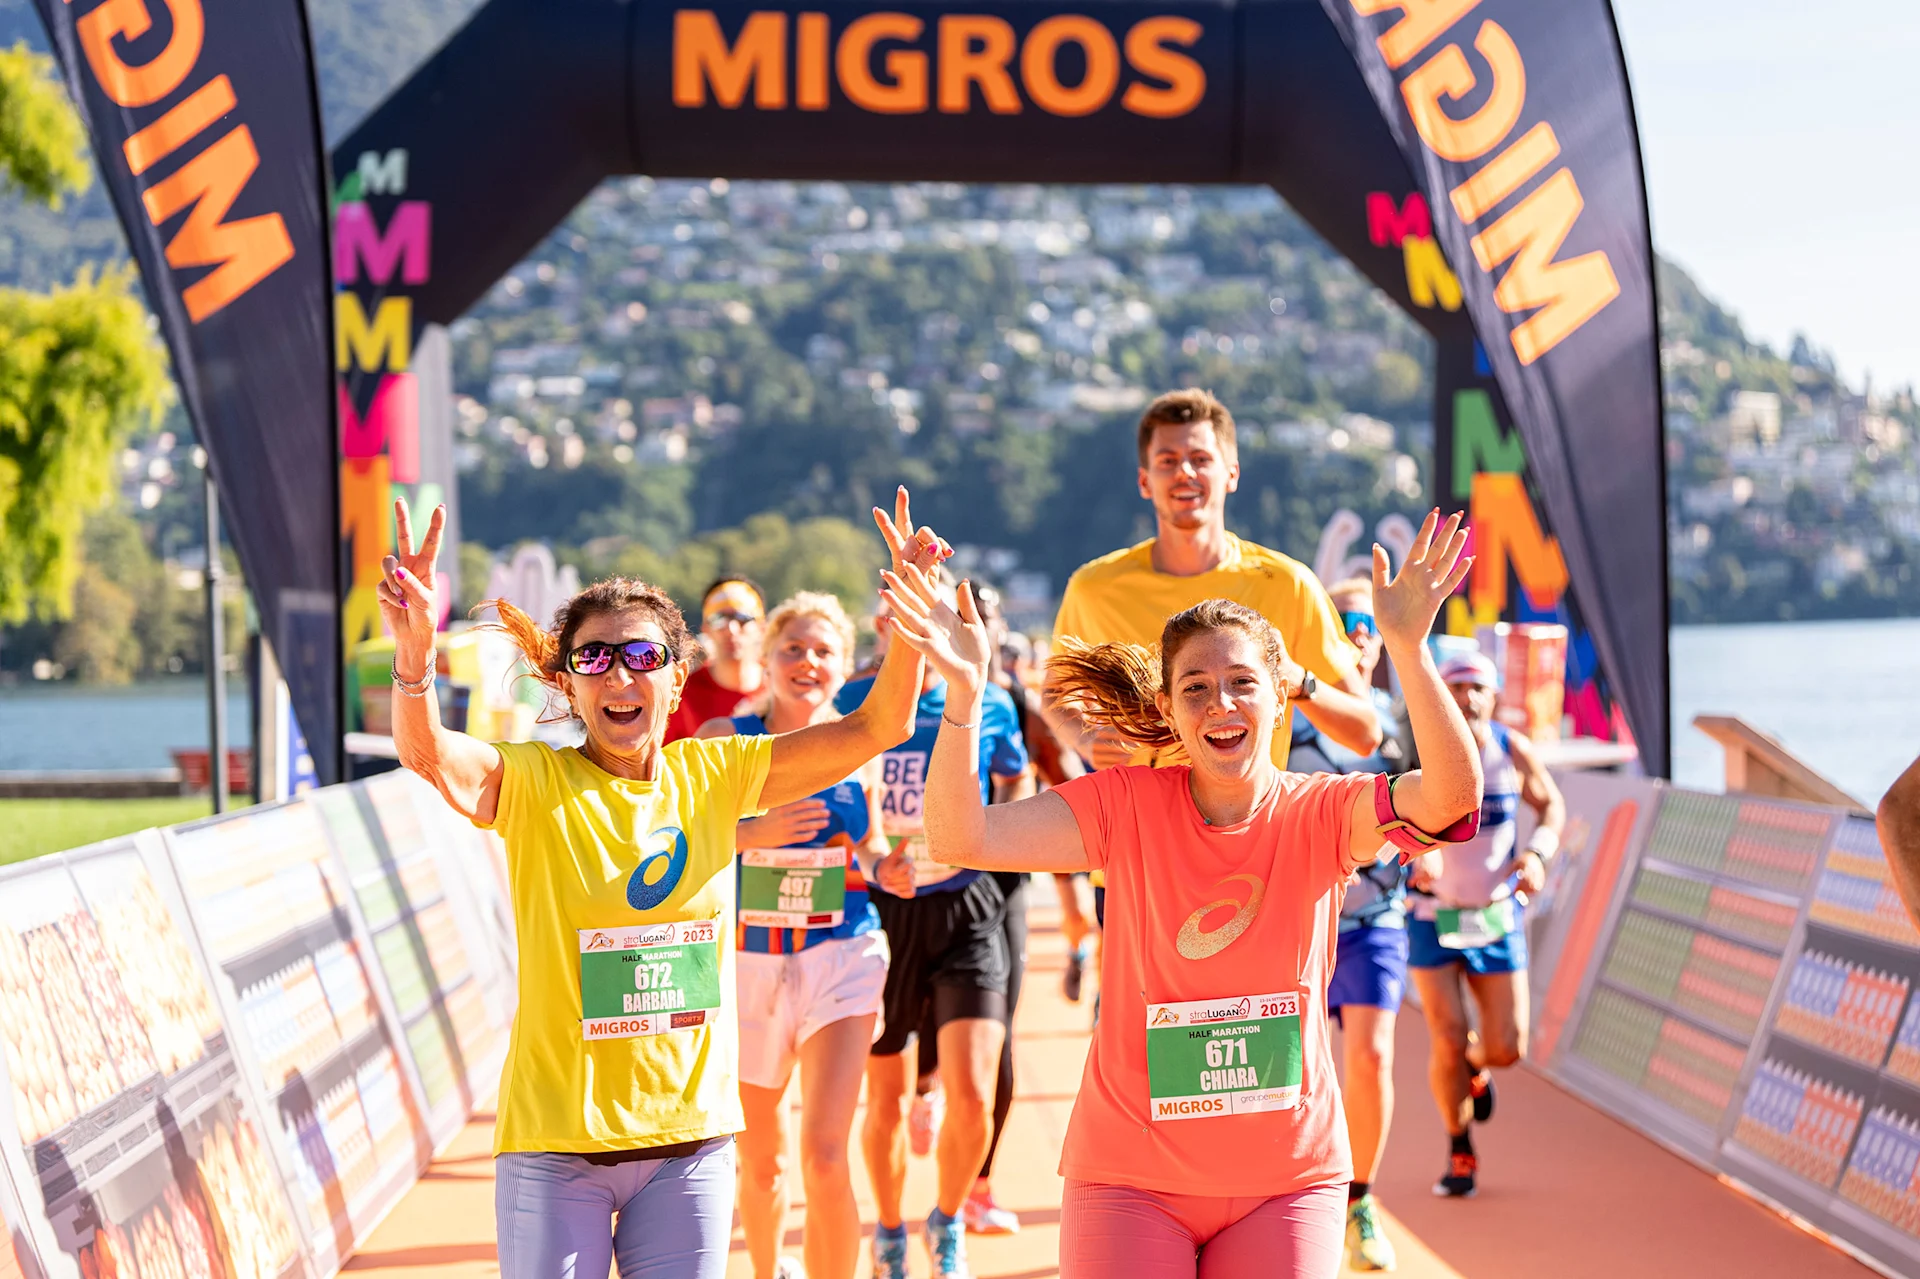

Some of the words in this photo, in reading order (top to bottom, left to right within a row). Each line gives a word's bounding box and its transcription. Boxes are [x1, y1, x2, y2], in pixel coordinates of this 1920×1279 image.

[672, 8, 1208, 119] MIGROS
[881, 789, 925, 816] AC
[778, 876, 814, 897] 497
[683, 929, 714, 943] 2023
[634, 962, 673, 991] 672
[622, 988, 686, 1014] BARBARA
[1189, 1007, 1247, 1020] straLUGANO
[1260, 1001, 1296, 1017] 2023
[589, 1019, 649, 1036] MIGROS
[1205, 1038, 1248, 1068] 671
[1200, 1066, 1259, 1092] CHIARA
[1158, 1098, 1224, 1116] MIGROS
